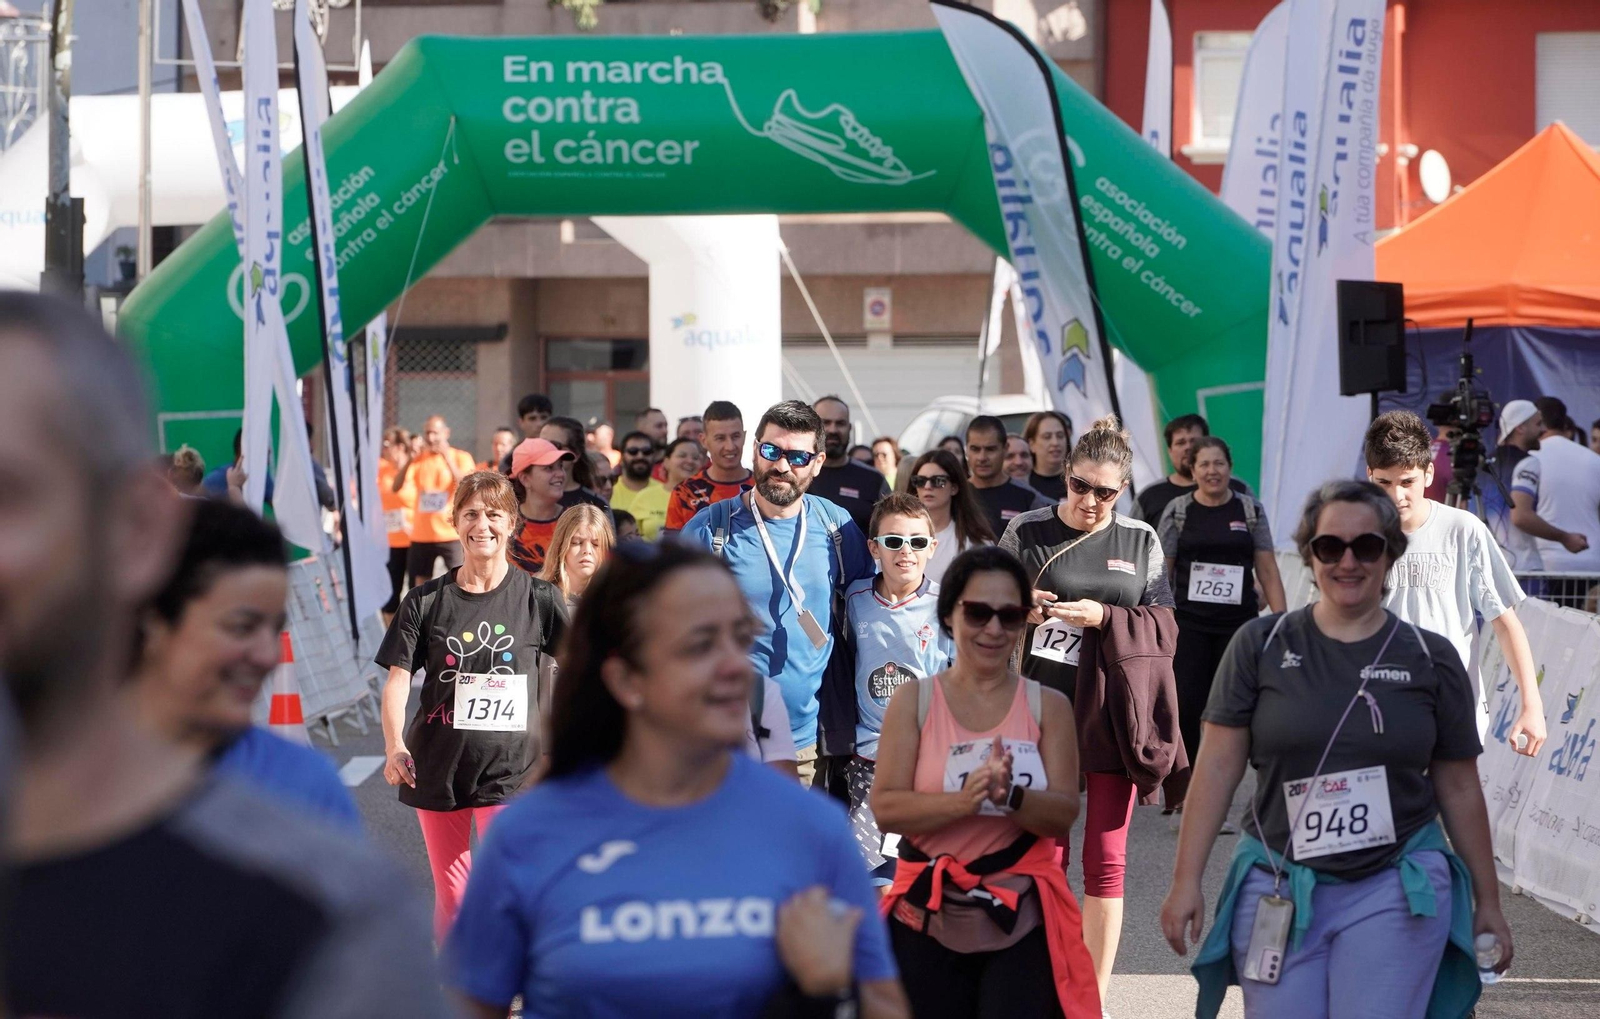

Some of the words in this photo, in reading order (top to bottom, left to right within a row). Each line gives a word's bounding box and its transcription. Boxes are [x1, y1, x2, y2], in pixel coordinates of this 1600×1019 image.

[503, 54, 555, 83] En
[566, 54, 725, 85] marcha
[502, 90, 641, 124] contra
[504, 129, 546, 164] el
[553, 130, 700, 165] cáncer
[375, 208, 395, 231] el
[392, 159, 448, 215] cáncer
[1095, 176, 1188, 250] asociación
[1080, 194, 1161, 259] española
[1084, 222, 1123, 260] ntra
[1121, 255, 1144, 274] el
[1140, 270, 1203, 318] cáncer
[1195, 580, 1234, 598] 1263
[1042, 628, 1082, 654] 127
[874, 685, 894, 697] Gali
[467, 698, 515, 721] 1314
[1305, 803, 1369, 842] 948
[579, 897, 775, 943] Lonza
